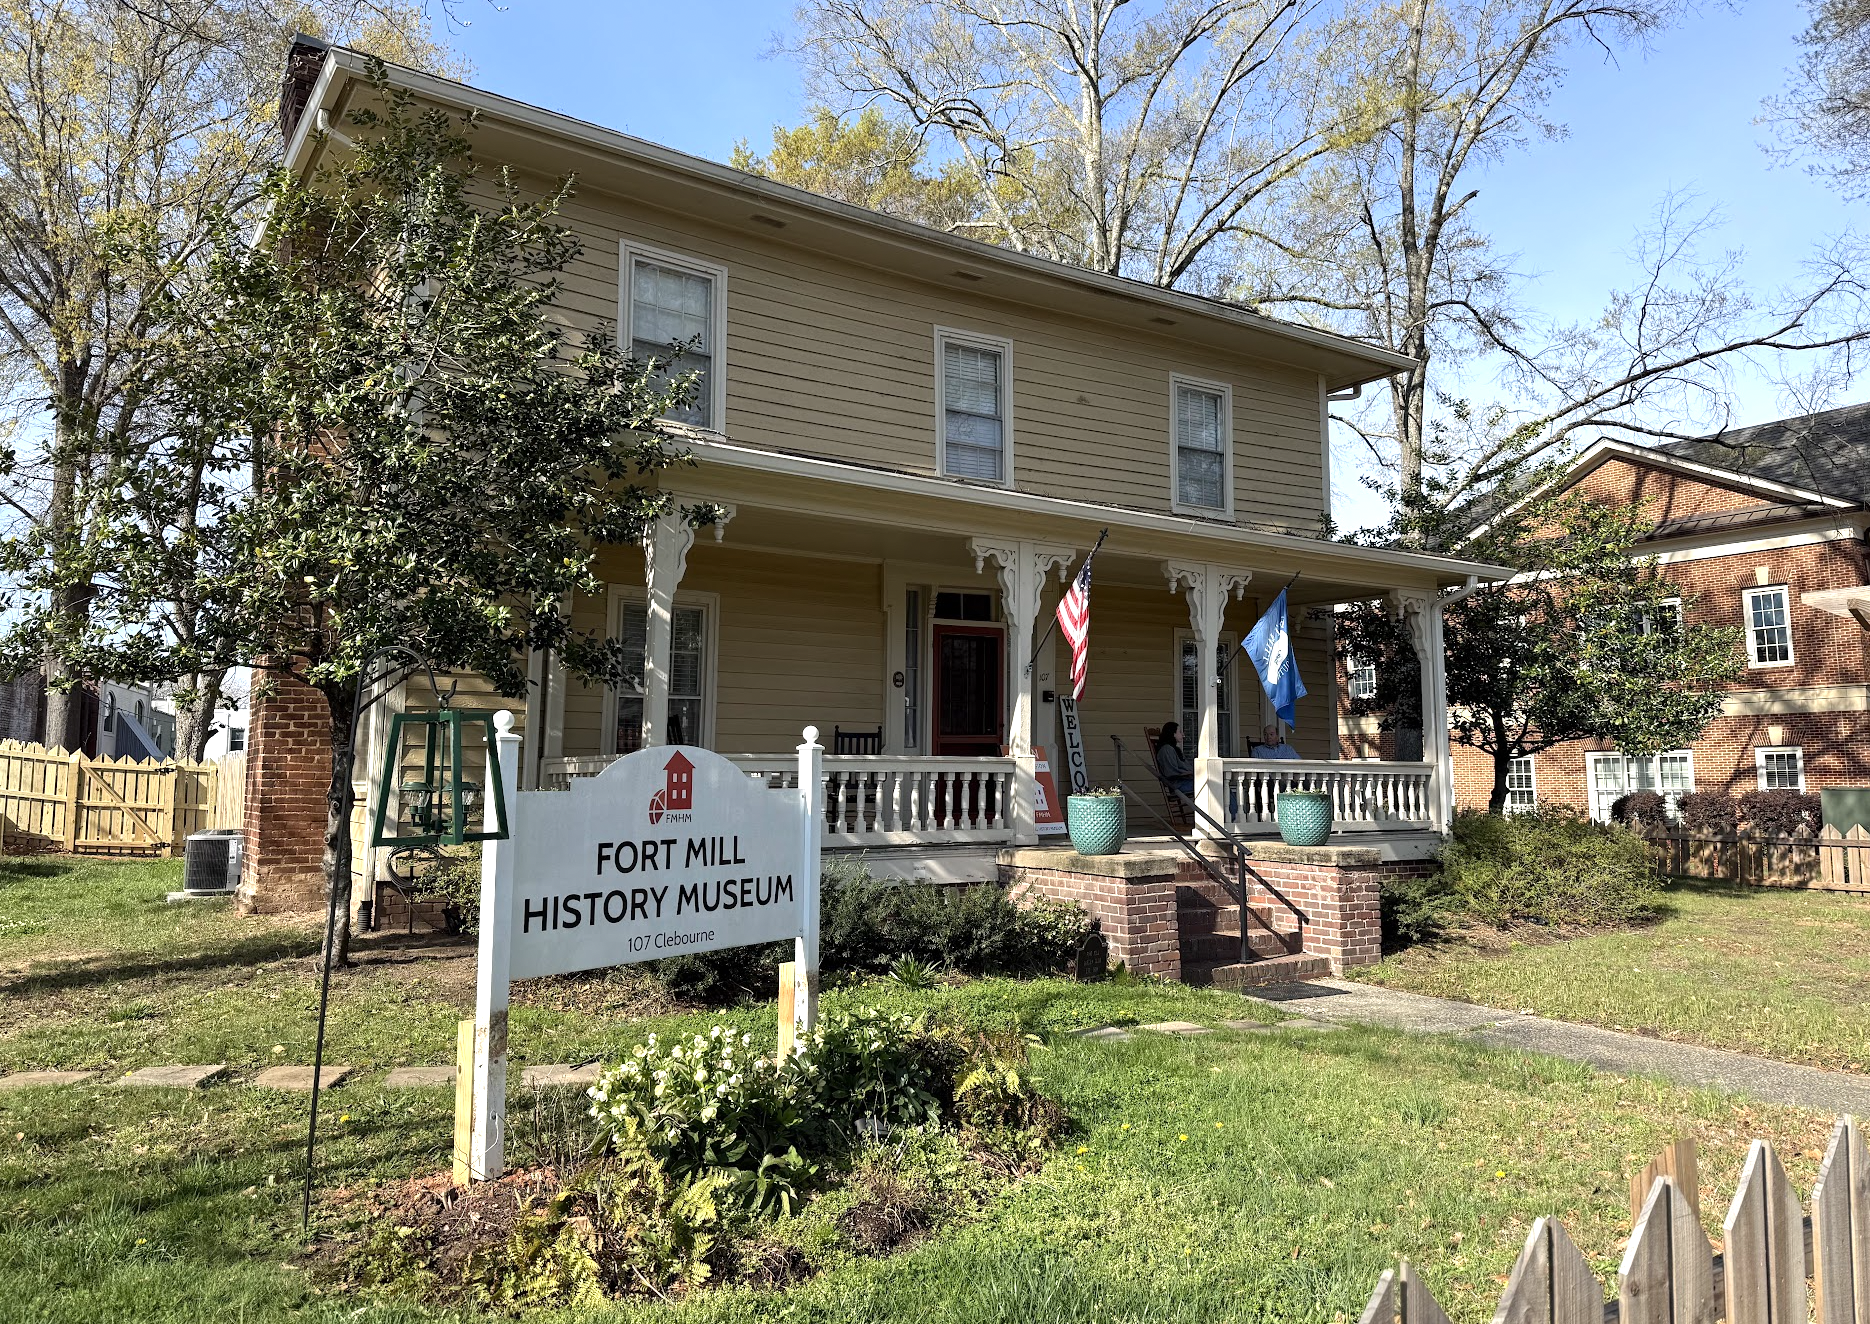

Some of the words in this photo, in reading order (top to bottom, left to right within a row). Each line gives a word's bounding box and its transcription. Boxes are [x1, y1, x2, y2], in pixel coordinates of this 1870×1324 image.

[1039, 672, 1050, 683] 107
[1062, 698, 1086, 789] WELCO
[665, 813, 692, 824] FMHM
[597, 838, 677, 876] FORT
[685, 835, 746, 869] MILL
[523, 885, 668, 934] HISTORY
[676, 874, 794, 916] MUSEUM
[628, 934, 652, 953] 107
[654, 930, 715, 949] Clebourne
